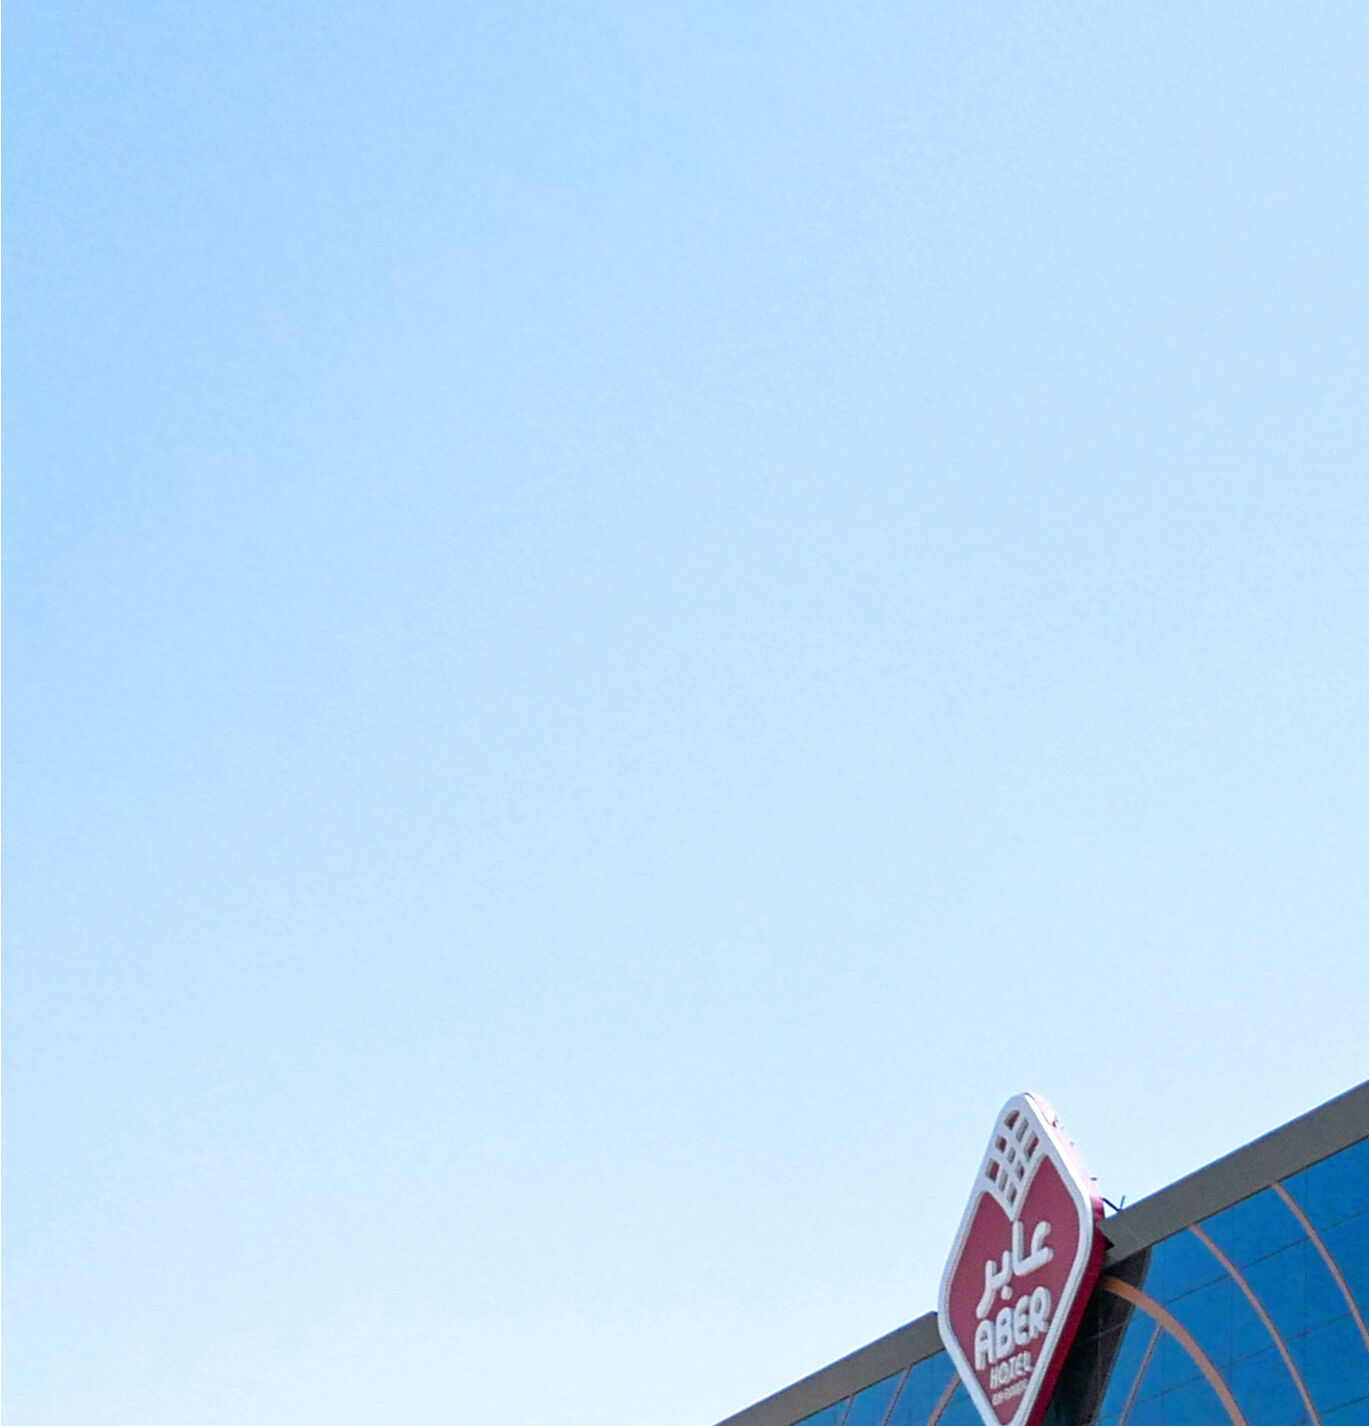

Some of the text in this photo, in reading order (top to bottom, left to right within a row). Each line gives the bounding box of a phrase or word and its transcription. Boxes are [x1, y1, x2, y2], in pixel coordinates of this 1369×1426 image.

[975, 1220, 1053, 1319] عابر
[974, 1286, 1051, 1370] ABER
[990, 1350, 1032, 1389] HOTEL
